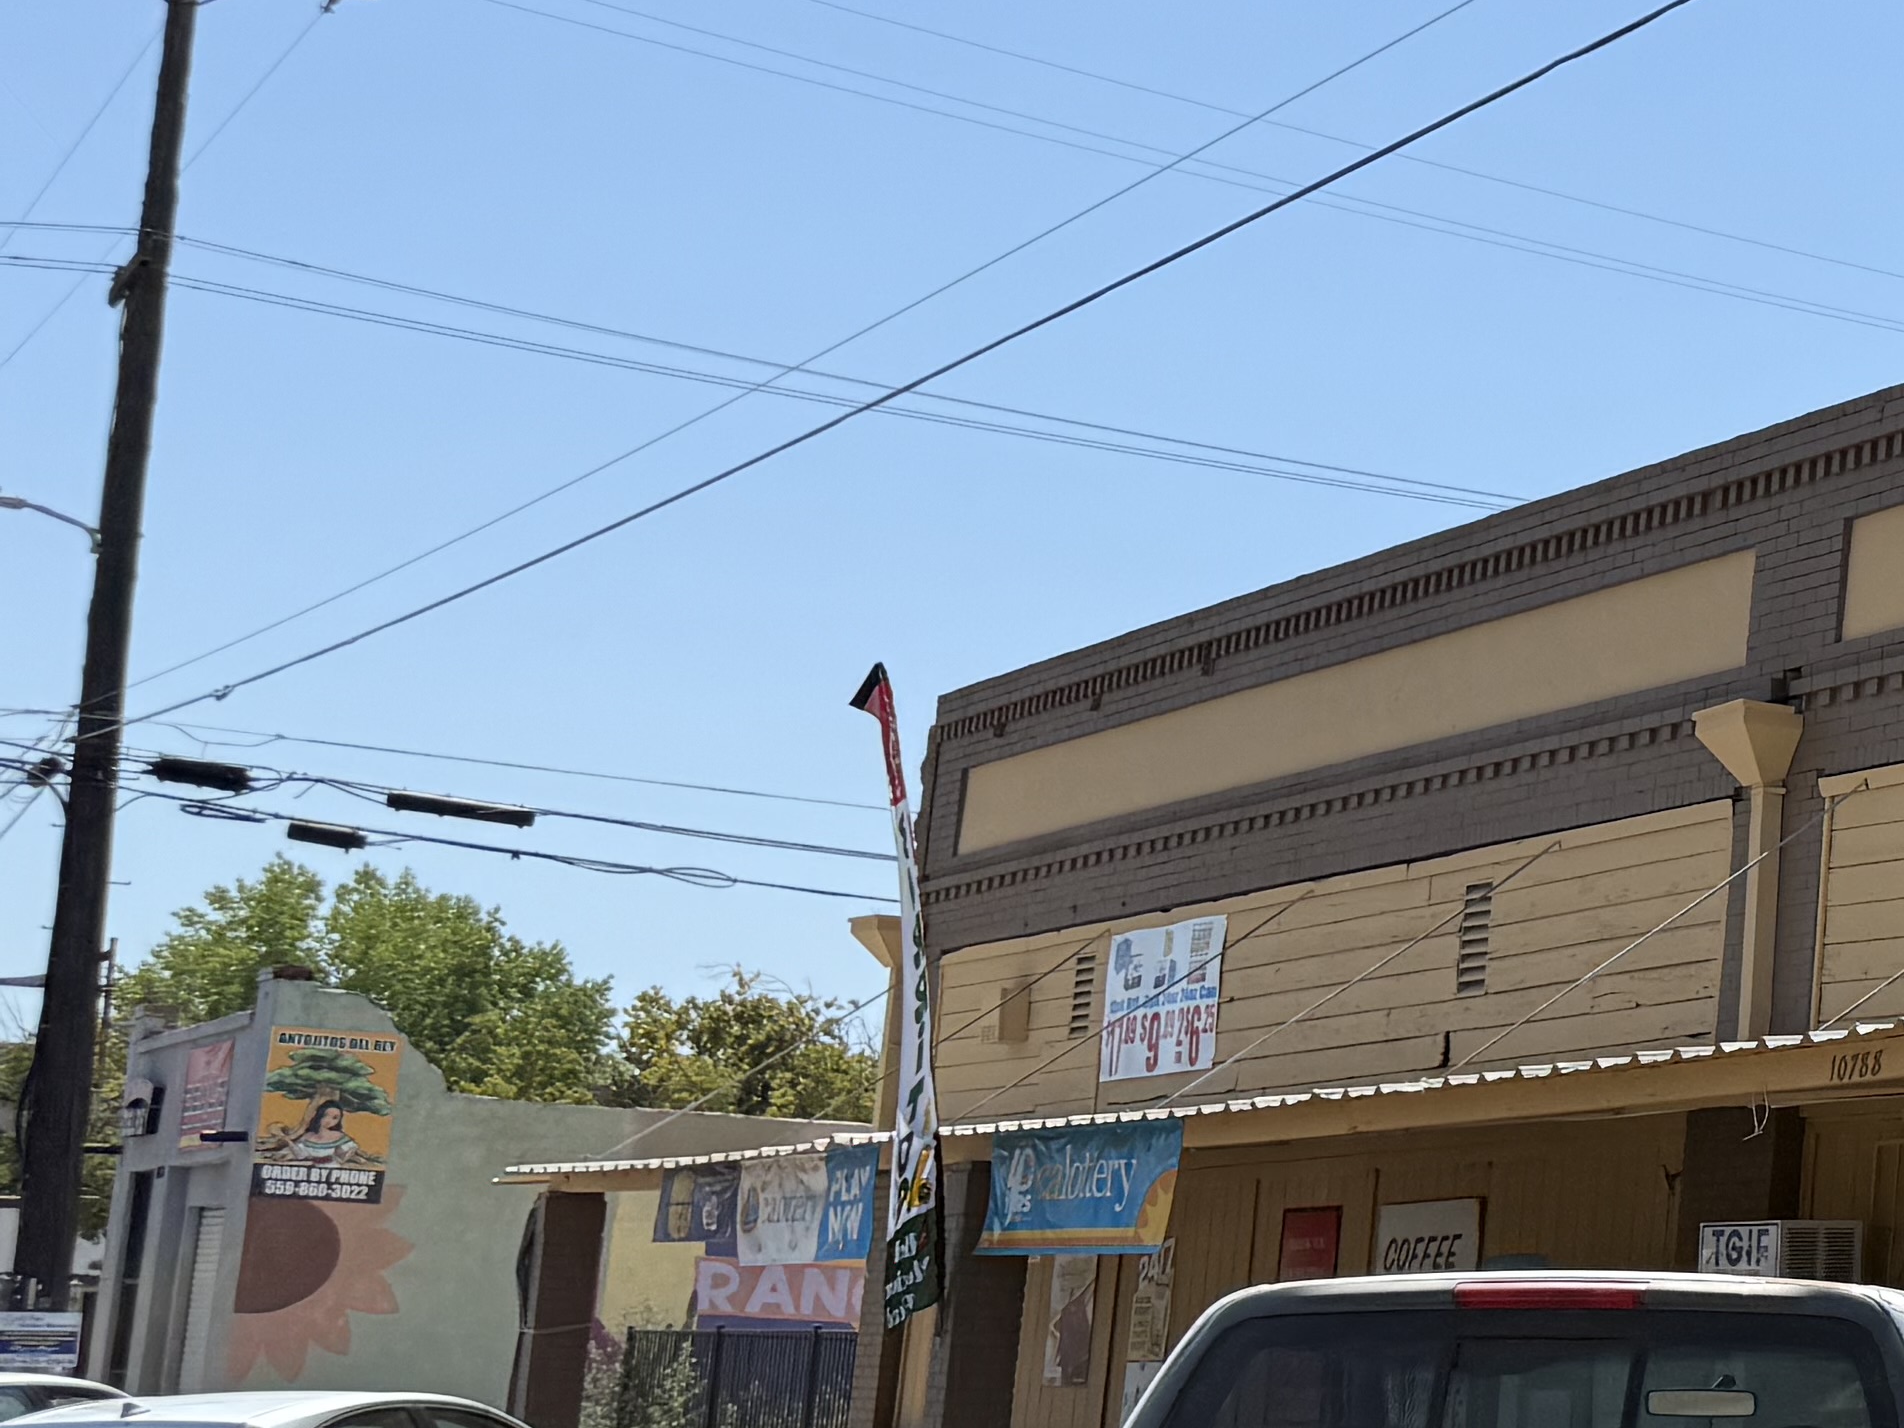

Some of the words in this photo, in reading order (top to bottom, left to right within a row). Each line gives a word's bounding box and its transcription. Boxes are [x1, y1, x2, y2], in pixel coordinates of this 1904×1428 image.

[1829, 1049, 1883, 1082] 10788
[329, 1168, 375, 1185] PHONE
[829, 1165, 871, 1202] PLAY
[1037, 1144, 1136, 1212] calottery
[1384, 1233, 1463, 1271] COFFEE
